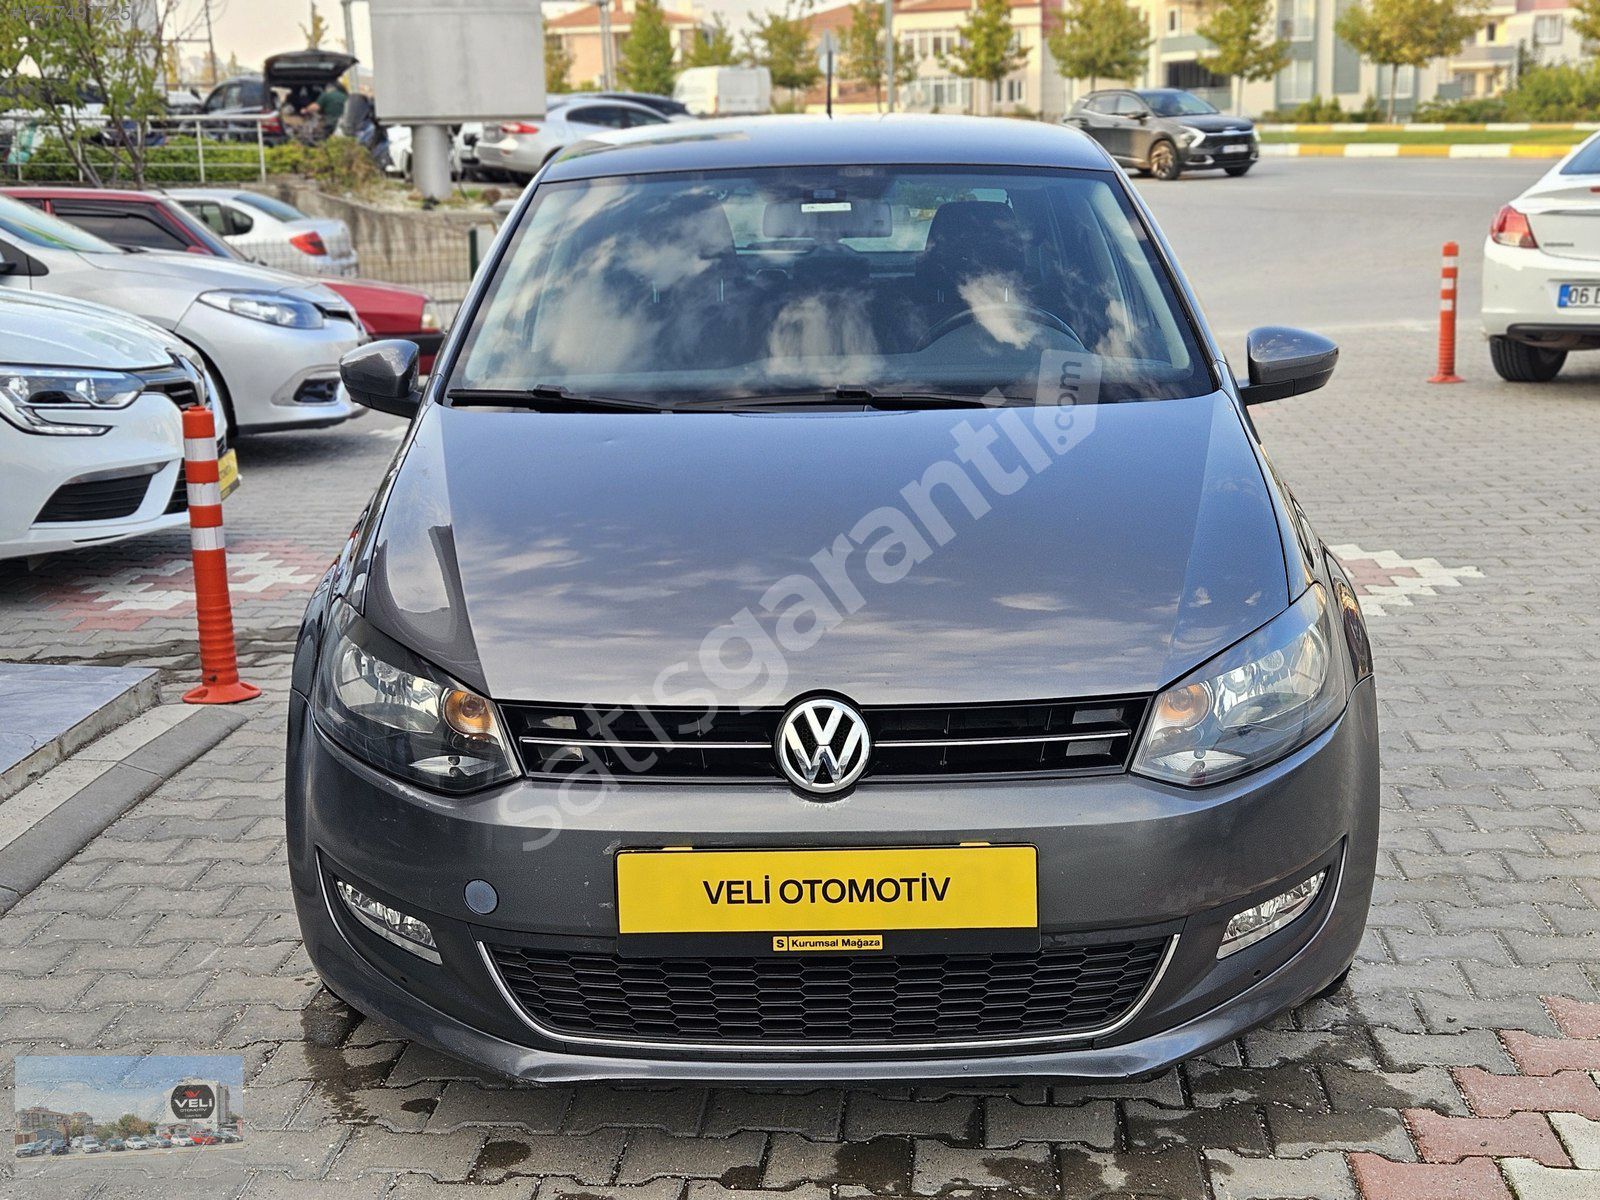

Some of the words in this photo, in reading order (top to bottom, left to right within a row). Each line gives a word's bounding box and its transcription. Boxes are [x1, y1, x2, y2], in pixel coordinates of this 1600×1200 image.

[1568, 287, 1589, 304] 06
[703, 875, 770, 904] VELİ
[779, 872, 951, 904] OTOMOTİV
[791, 939, 839, 948] Kurumsal
[841, 938, 880, 948] Mağaza
